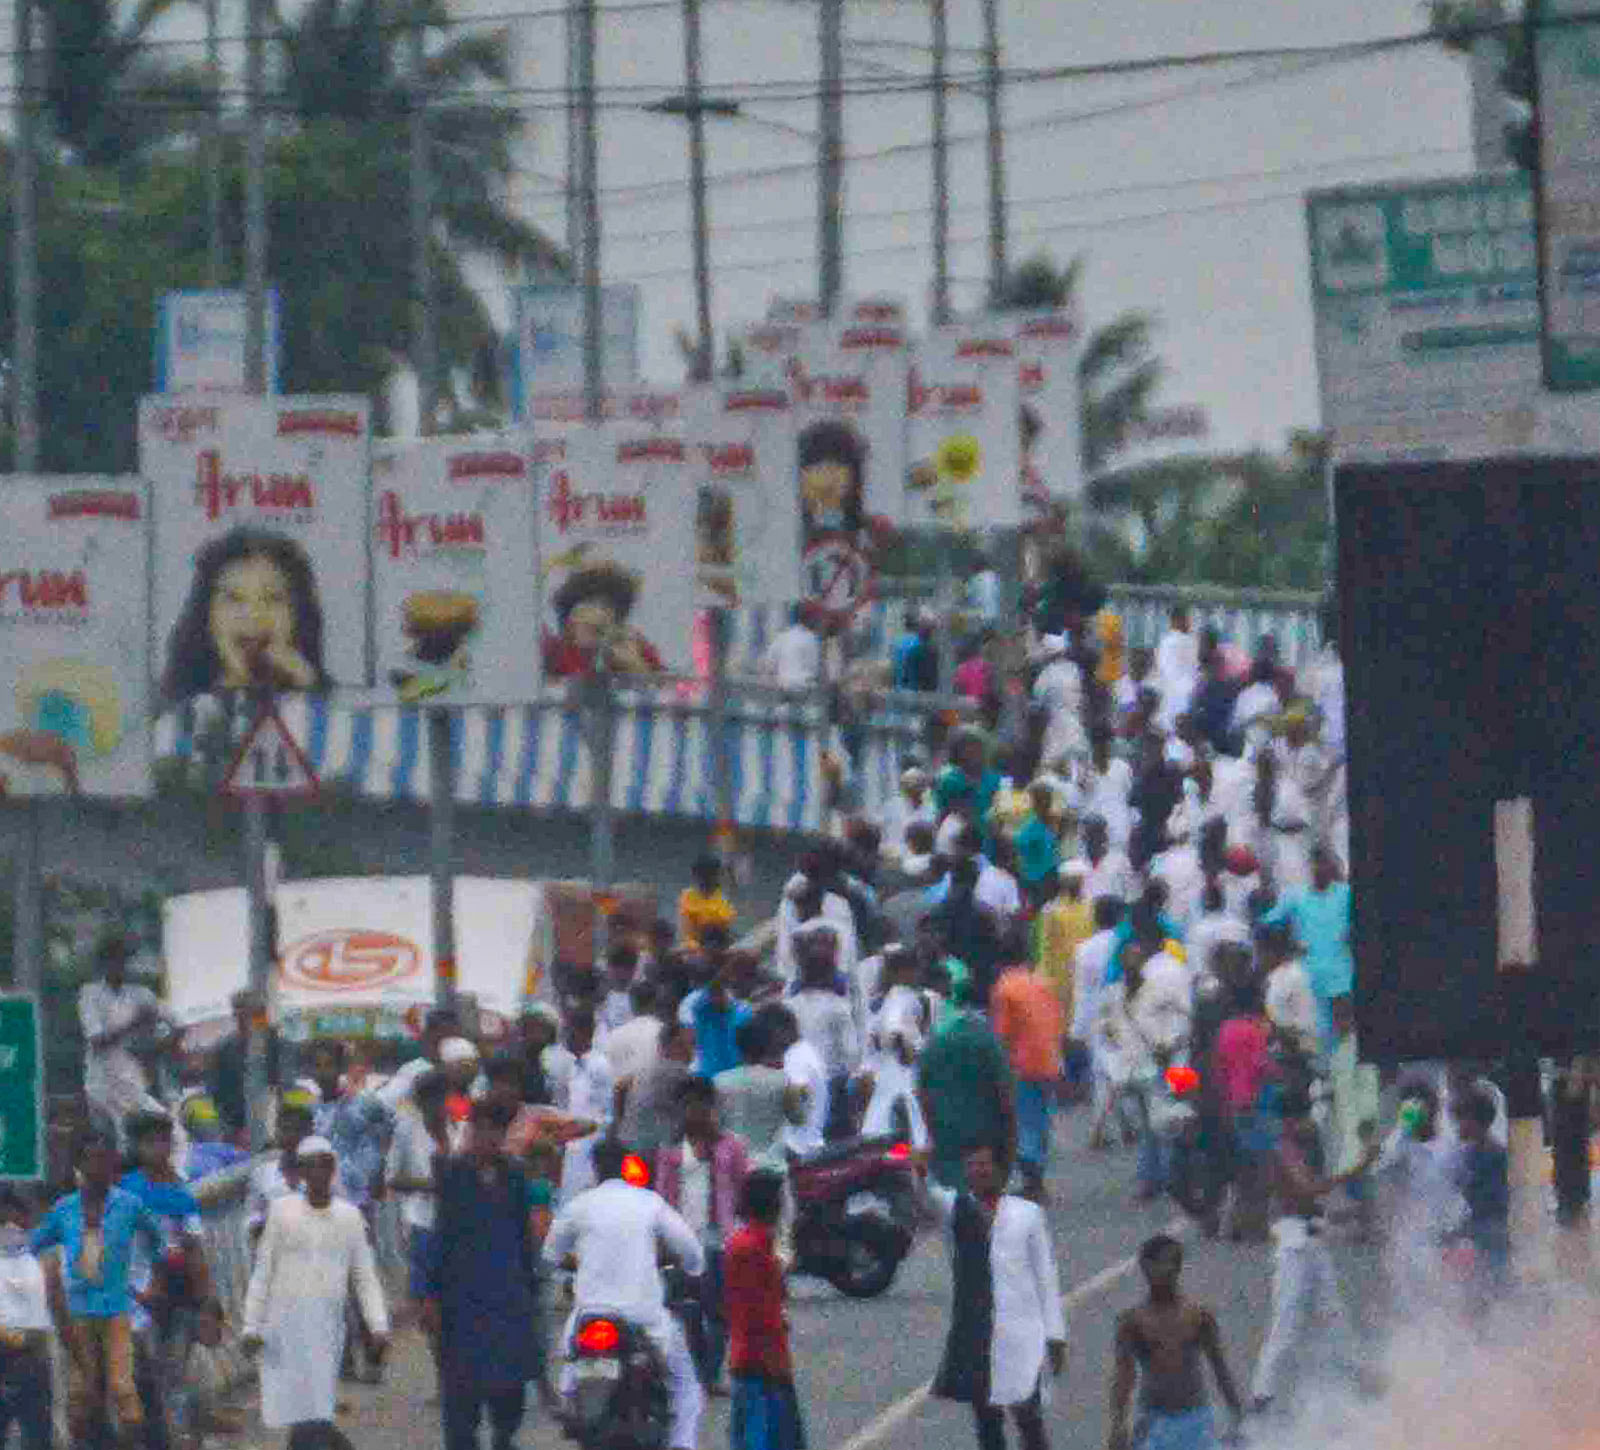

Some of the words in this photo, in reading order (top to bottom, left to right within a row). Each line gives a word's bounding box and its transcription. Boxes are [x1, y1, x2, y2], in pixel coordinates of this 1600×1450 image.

[194, 447, 315, 521] Arun
[550, 469, 647, 532] Arun
[377, 489, 485, 559] Arun
